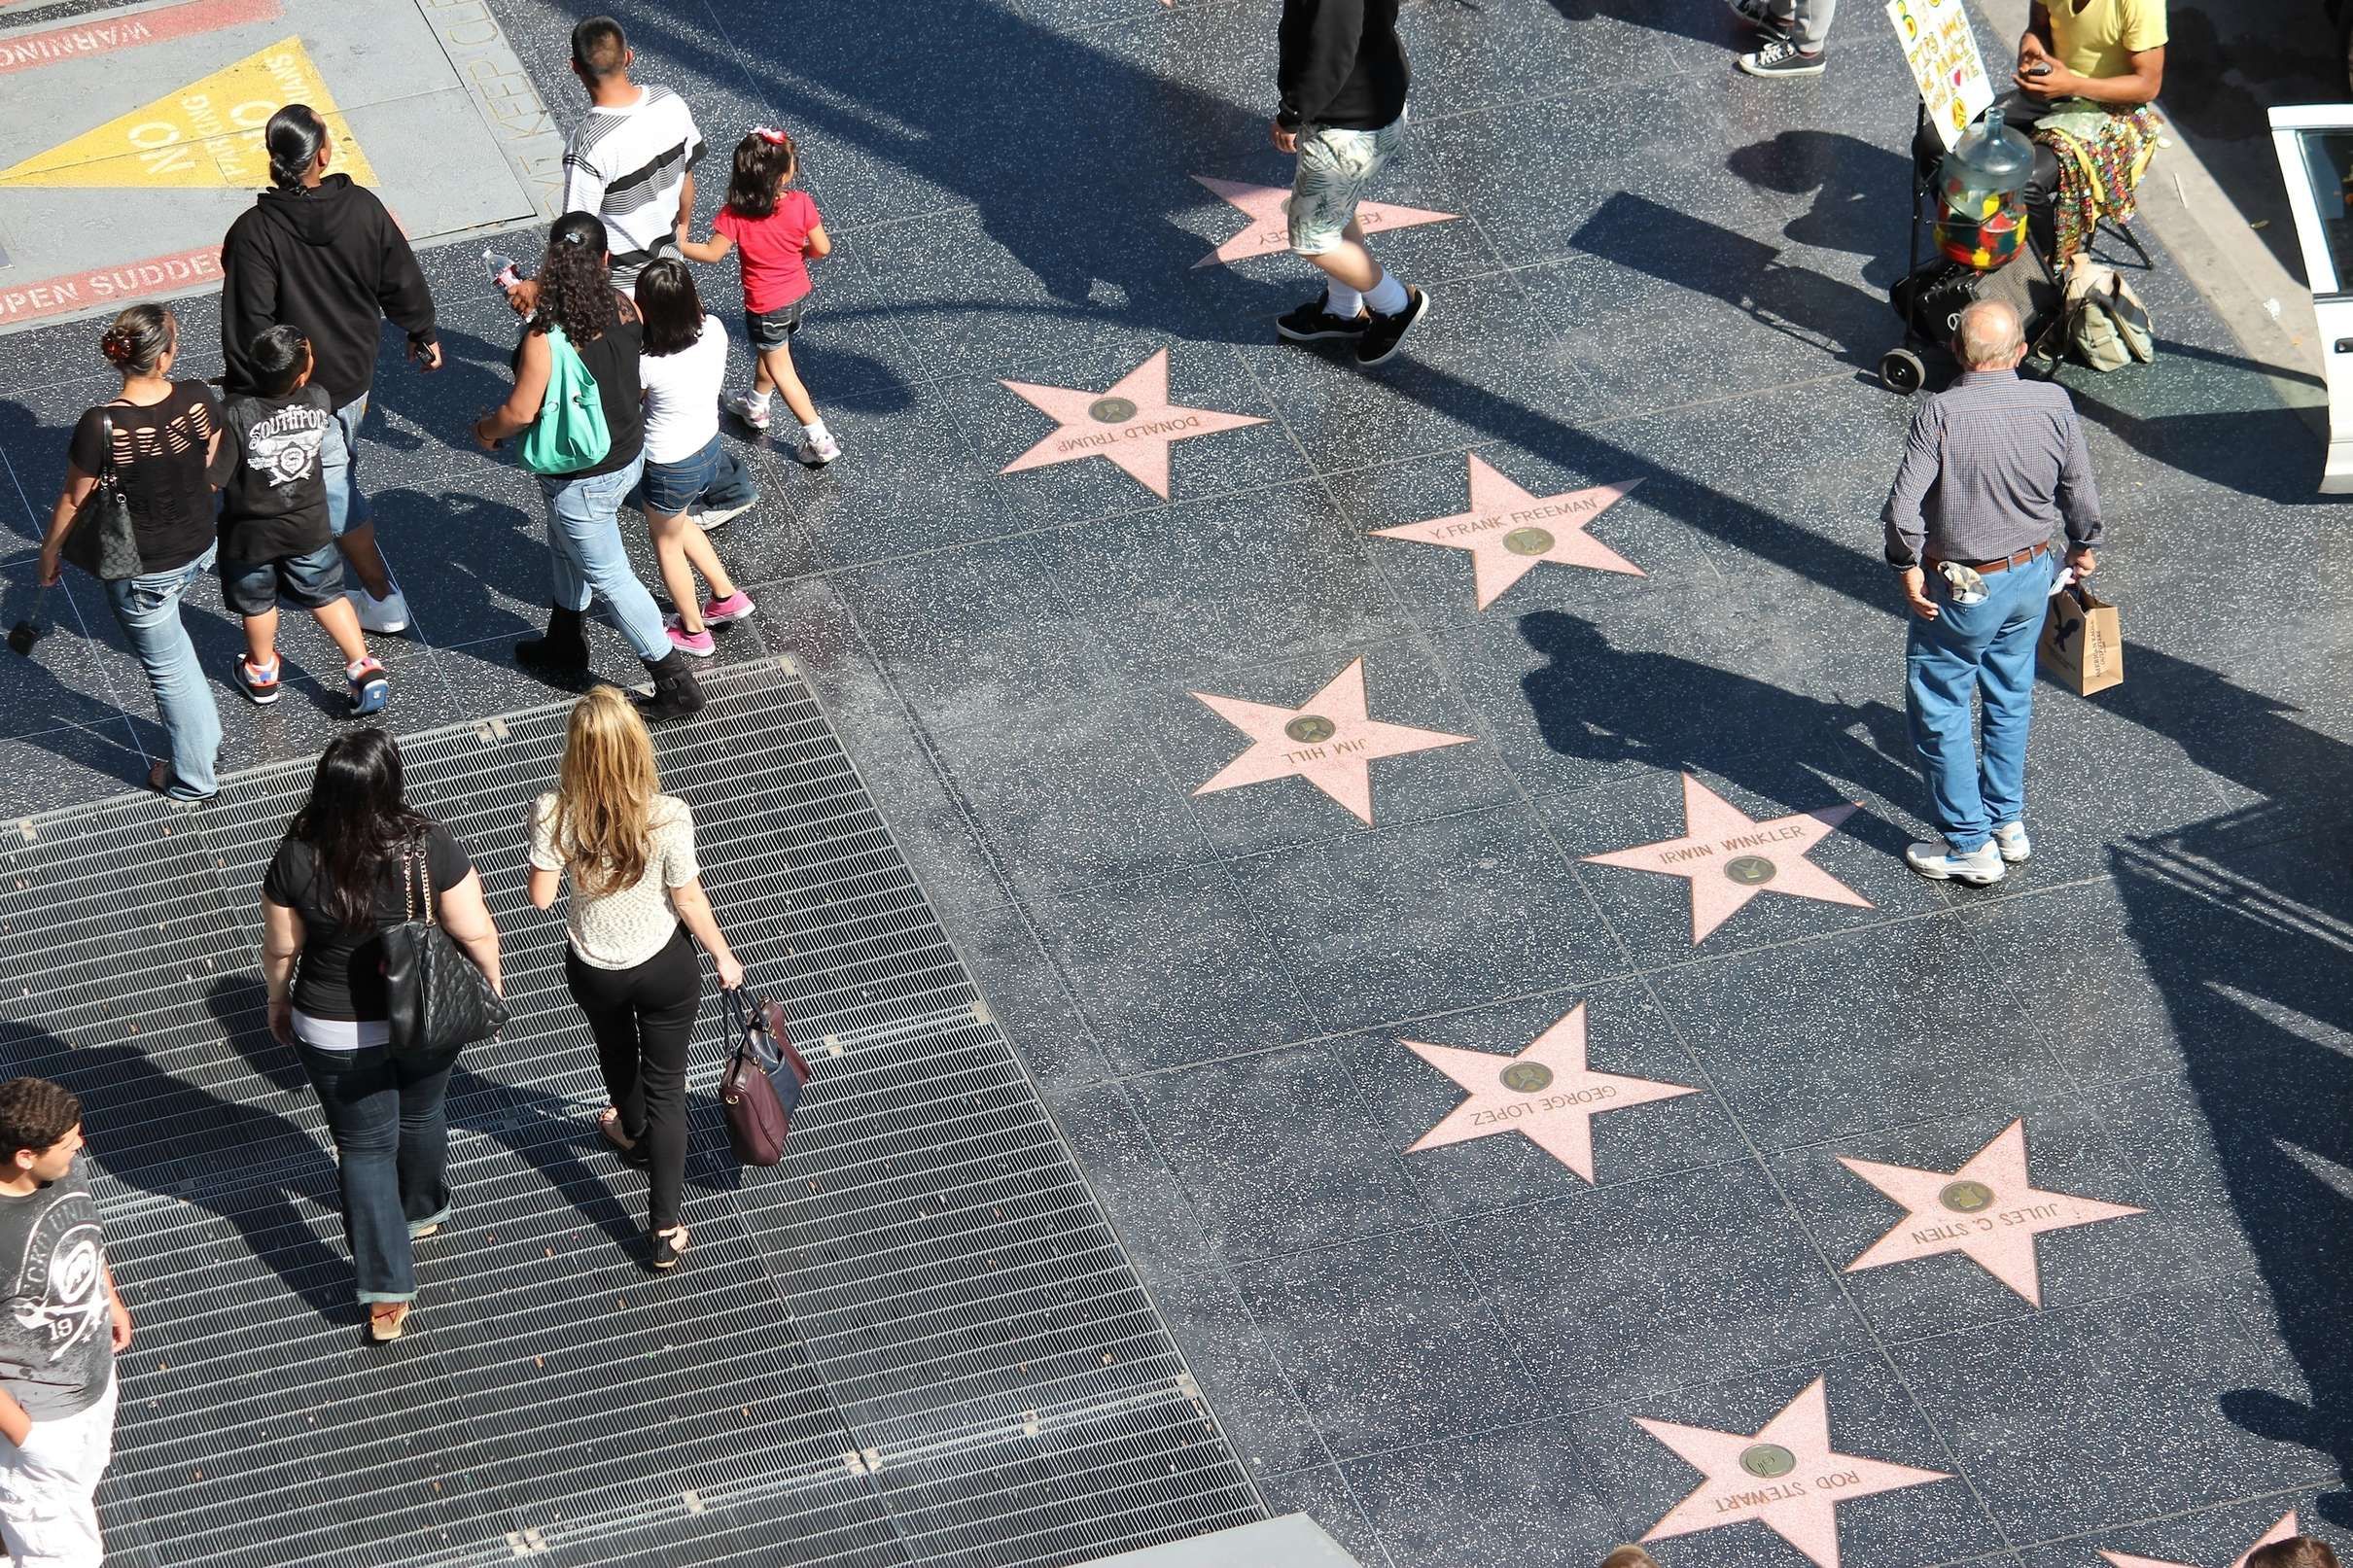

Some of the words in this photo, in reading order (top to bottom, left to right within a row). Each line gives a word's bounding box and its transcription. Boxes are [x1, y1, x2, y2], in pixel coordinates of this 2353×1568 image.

[468, 59, 558, 141] KEEP
[180, 92, 248, 177] PARKING
[127, 121, 196, 175] NO
[0, 282, 81, 316] PEN
[89, 252, 223, 296] SUDDE
[1124, 416, 1200, 438] DONALD
[1057, 432, 1119, 453] TRUMP
[1428, 528, 1446, 540] Y.
[1446, 516, 1506, 538] FRANK
[1510, 498, 1598, 524] FREEMAN
[1281, 747, 1326, 764] HILL
[1333, 738, 1370, 755] JIM
[1659, 844, 1714, 865] IRWIN
[1720, 824, 1806, 852] WINKLER
[1538, 1085, 1617, 1111] GEORGE
[1470, 1102, 1534, 1126] LOPEZ
[1972, 1217, 1993, 1232] C.
[1998, 1202, 2058, 1227] JULES
[23, 1231, 52, 1288] CKO
[49, 1200, 95, 1232] UNL
[1912, 1222, 1969, 1244] STIEN
[48, 1317, 74, 1342] 19
[1815, 1470, 1861, 1489] ROD
[1714, 1481, 1807, 1514] STEWART
